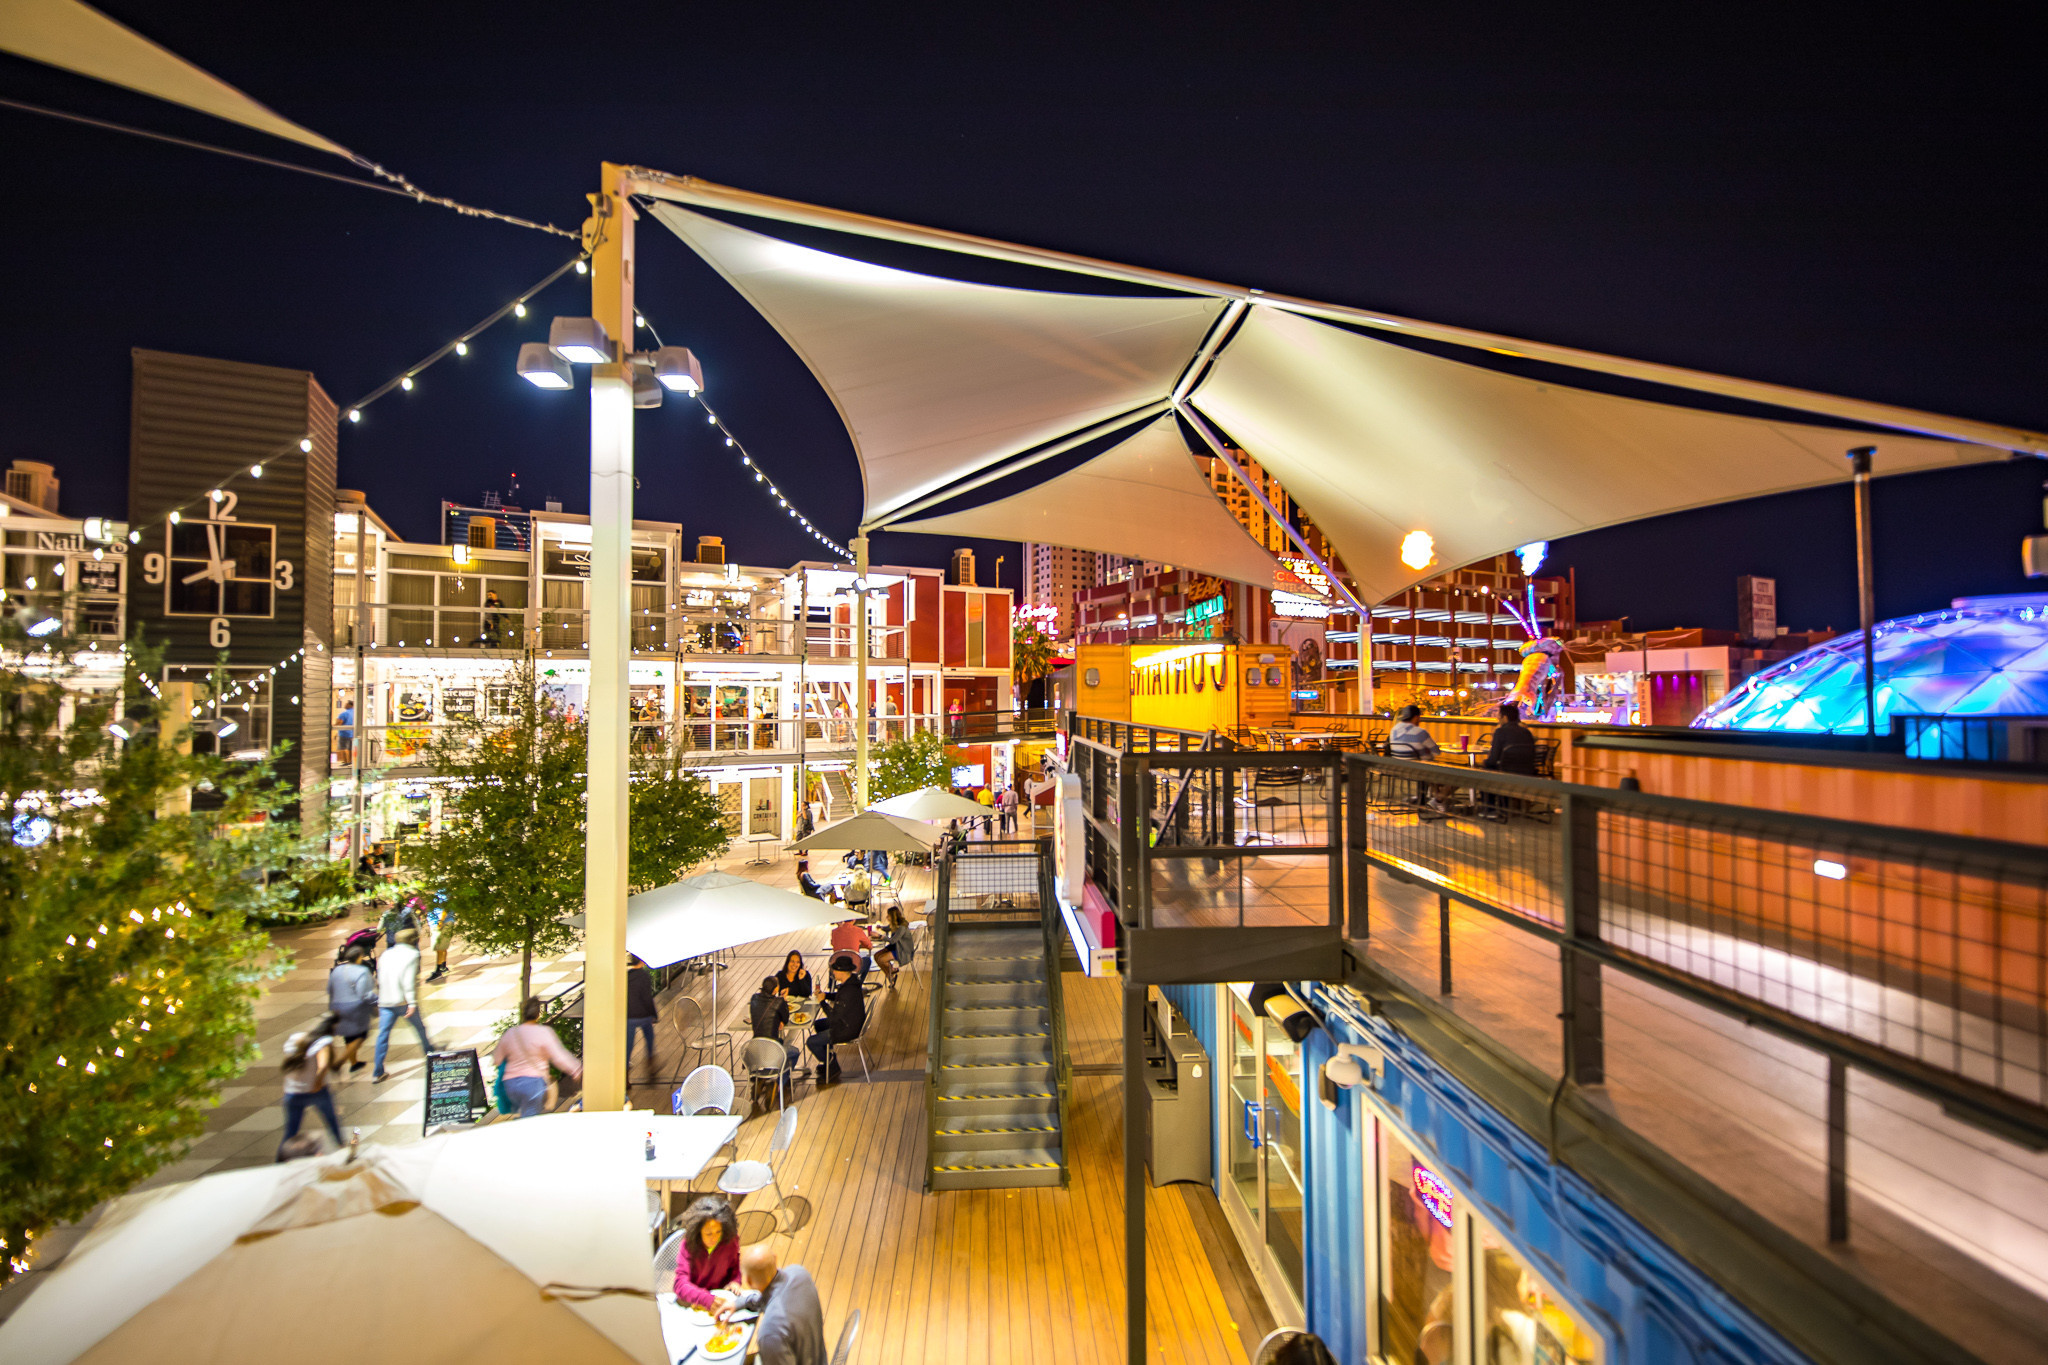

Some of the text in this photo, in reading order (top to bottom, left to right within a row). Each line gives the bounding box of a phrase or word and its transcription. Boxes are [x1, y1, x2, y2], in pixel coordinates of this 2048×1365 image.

[205, 490, 238, 522] 12
[38, 532, 86, 552] Nail
[144, 553, 165, 584] 9
[275, 560, 294, 590] 3
[1293, 562, 1310, 573] EL
[210, 618, 231, 648] 6
